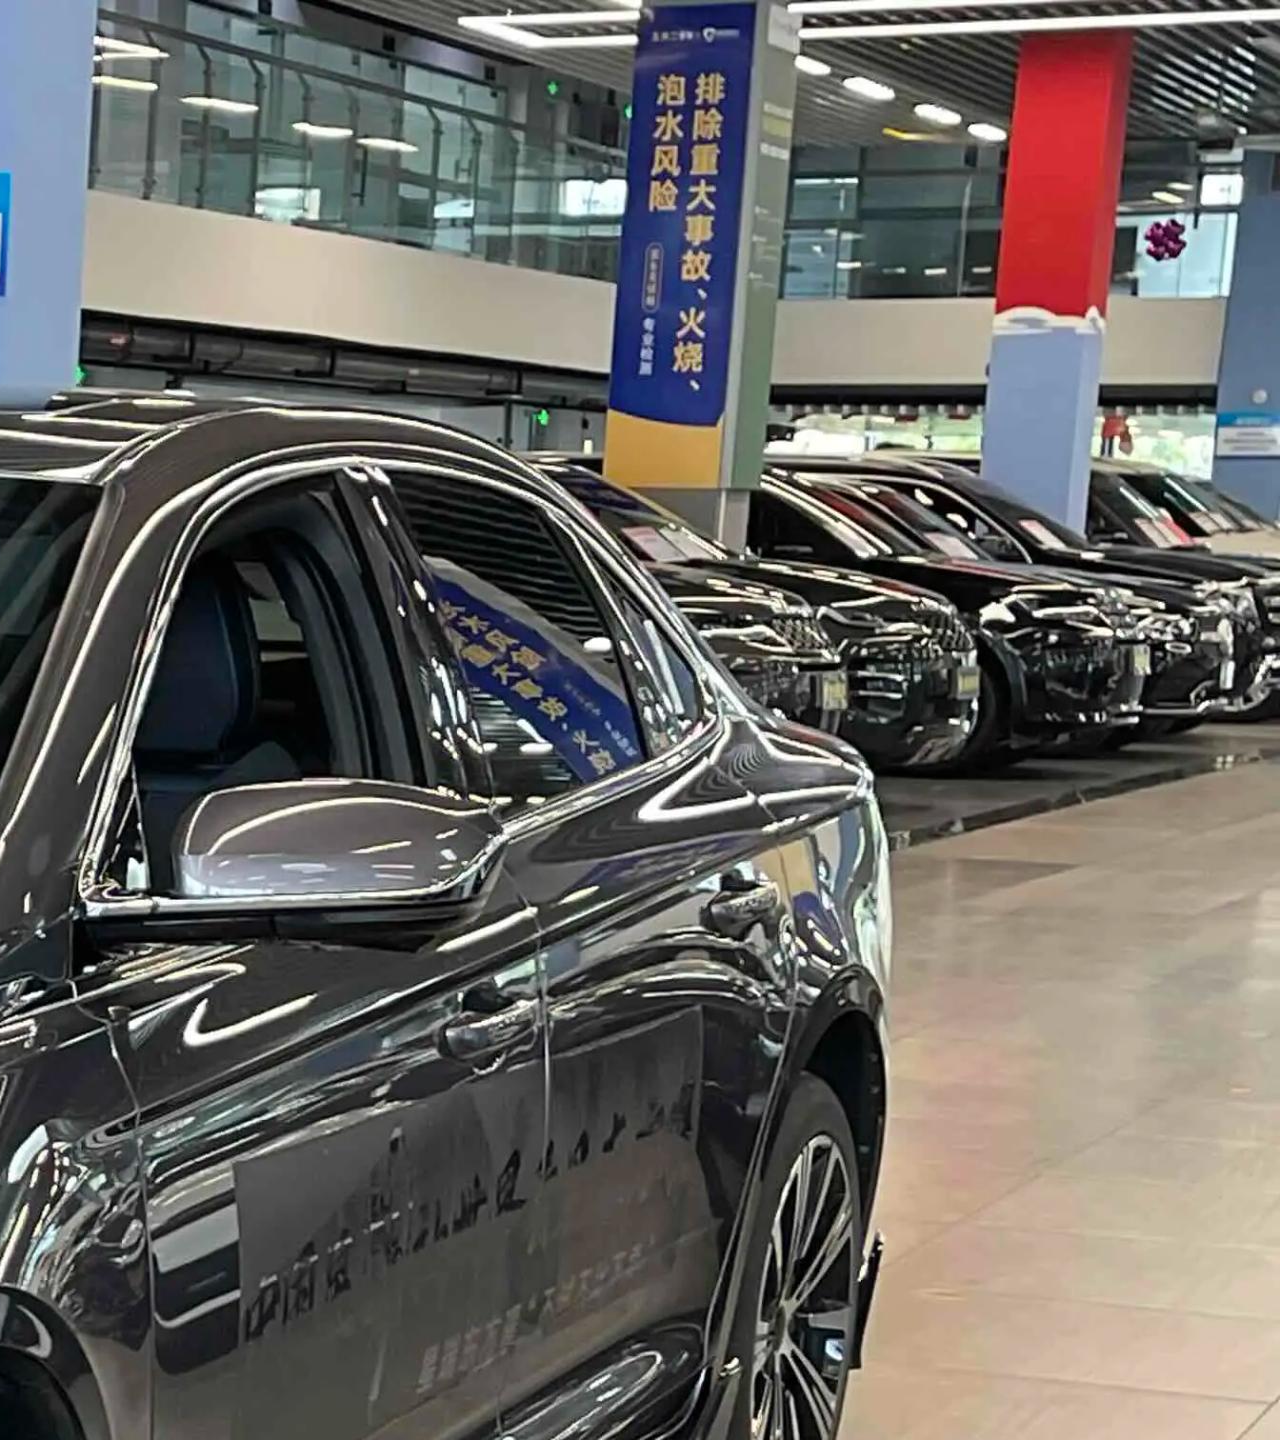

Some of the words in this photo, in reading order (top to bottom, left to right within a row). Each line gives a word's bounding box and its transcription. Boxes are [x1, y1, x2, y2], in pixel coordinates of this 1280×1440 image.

[648, 73, 686, 212] 泡水风险
[671, 72, 726, 391] 排除重大事故、火烧、
